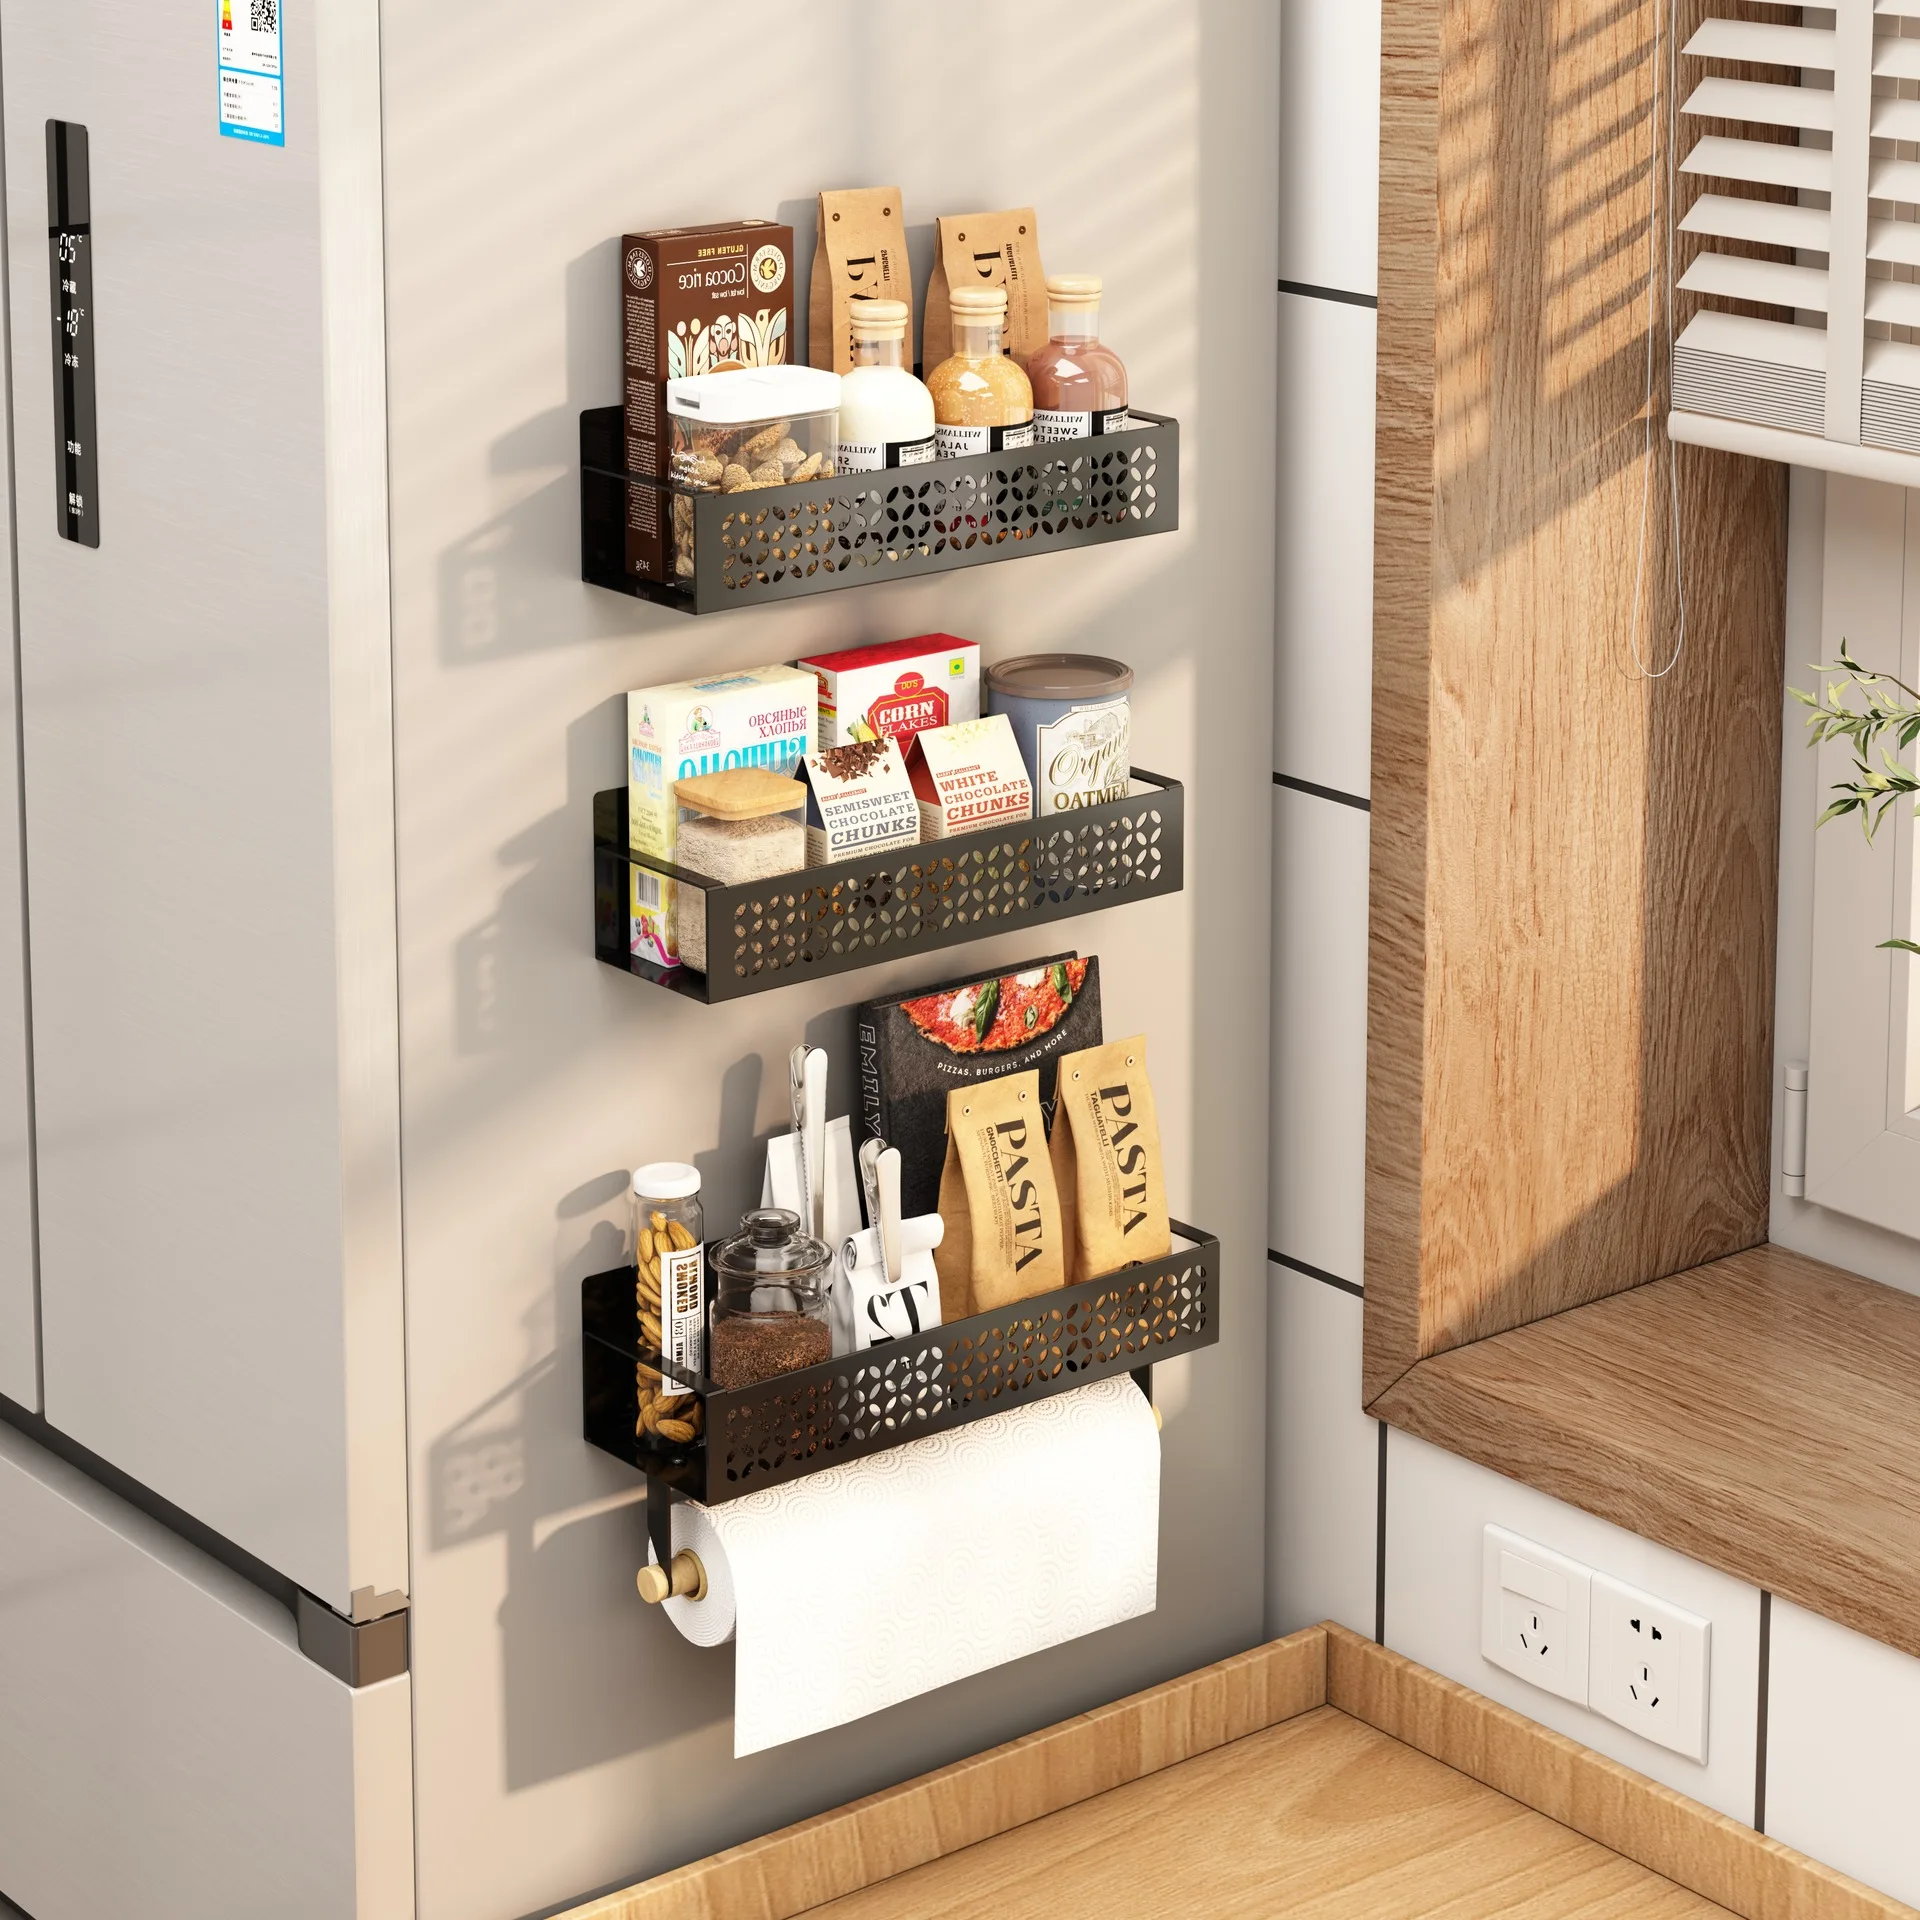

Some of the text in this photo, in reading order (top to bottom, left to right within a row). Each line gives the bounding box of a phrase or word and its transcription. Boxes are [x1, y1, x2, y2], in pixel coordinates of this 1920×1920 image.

[901, 680, 919, 690] DD'S
[879, 700, 934, 725] CORN
[759, 718, 807, 739] ХЛОПЬЯ
[879, 715, 938, 737] FLAKES
[939, 770, 998, 792] WHITE
[945, 779, 1028, 804] CHOCOLATE
[825, 790, 910, 817] SEMISWEET
[829, 803, 915, 829] CHOCOLATE
[946, 792, 1030, 820] CHUNKS
[831, 816, 917, 845] CHUNKS
[949, 823, 978, 833] PREMIUM
[979, 815, 1014, 828] CHOCOLATE
[833, 847, 863, 859] PREMIUM
[864, 841, 901, 852] CHOCOLATE
[937, 1062, 972, 1077] PIZZAS,
[1024, 1050, 1042, 1064] AND
[1044, 1030, 1068, 1051] MORE
[859, 1023, 881, 1137] EMILY
[1090, 1091, 1110, 1147] TAGLIATELLI
[986, 1126, 1004, 1183] GNOCCHETTI
[1098, 1081, 1147, 1238] PASTA
[994, 1116, 1043, 1275] PASTA
